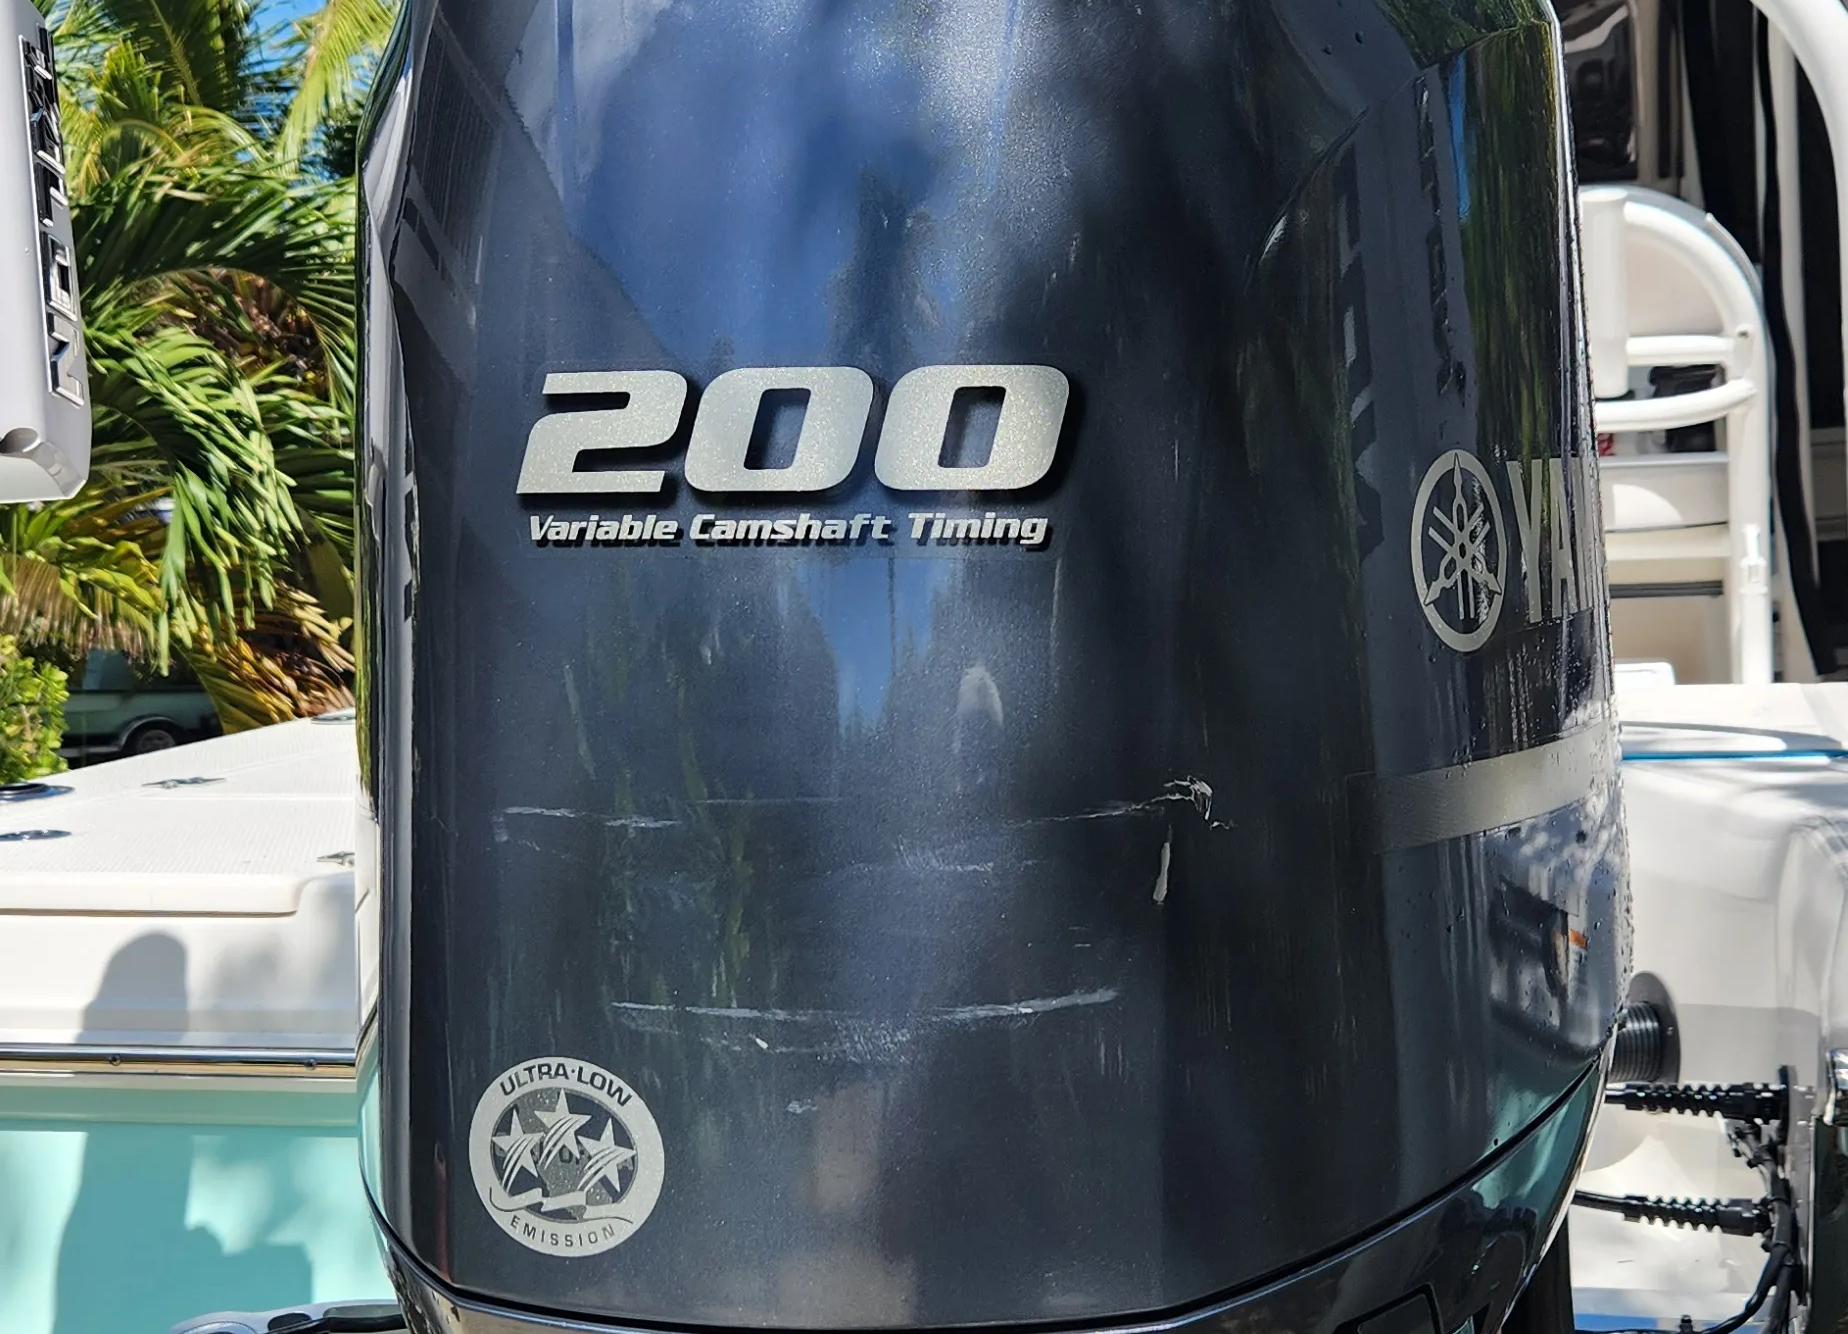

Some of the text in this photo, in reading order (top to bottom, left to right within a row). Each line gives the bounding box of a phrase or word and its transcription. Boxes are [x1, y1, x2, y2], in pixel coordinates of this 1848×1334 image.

[516, 365, 1070, 494] 200
[530, 511, 1049, 545] Variable Camshaft Timing
[510, 1214, 616, 1248] EMISSION
